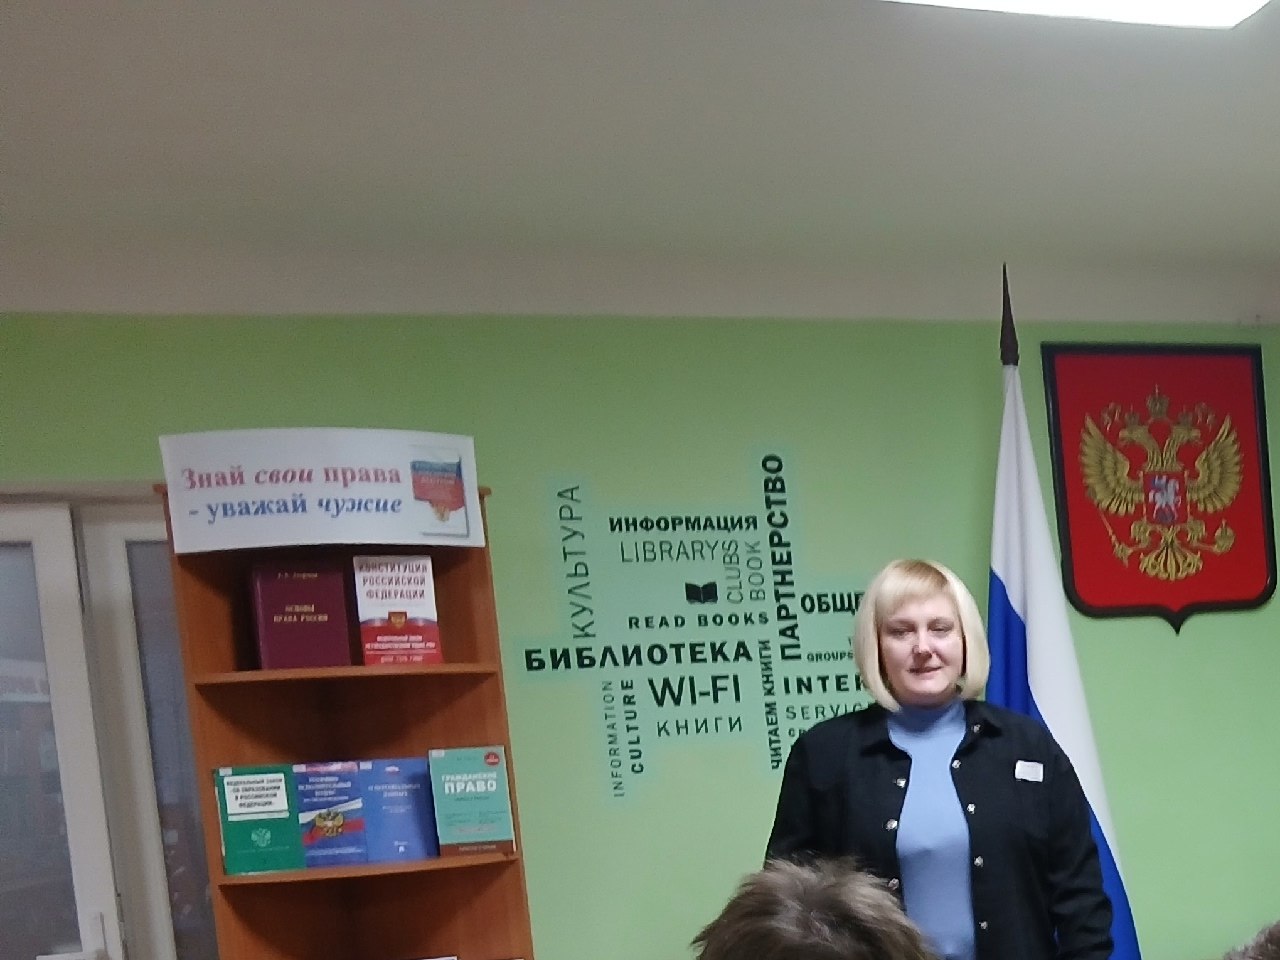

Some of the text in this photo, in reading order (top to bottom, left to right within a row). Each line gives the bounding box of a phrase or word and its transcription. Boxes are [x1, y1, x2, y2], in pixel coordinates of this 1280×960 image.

[181, 465, 246, 490] Знай
[254, 467, 314, 485] свои
[322, 466, 402, 488] права
[206, 493, 308, 525] уважай
[317, 497, 403, 519] чужие
[608, 515, 758, 533] ИНФОРМАЦИЯ
[358, 562, 428, 573] КОНСТИТУЦИЯ
[557, 485, 596, 639] КУЛЬТУРА
[721, 539, 744, 605] CLUBS
[744, 540, 766, 601] BOOK
[761, 454, 802, 661] ПАРТНЕРСТВО
[362, 575, 426, 587] РОССИЙСКОЙ
[366, 588, 425, 601] ФЕДЕРАЦИИ
[628, 611, 769, 630] READ BOOKS
[524, 640, 753, 672] БИБЛИОТЕКА
[647, 673, 741, 708] WI-FI
[758, 639, 783, 770] ЧИТАЕМ КНИГИ
[601, 680, 625, 798] INFORMATION
[620, 679, 645, 775] CULTURE
[656, 716, 743, 738] КНИГИ
[444, 780, 497, 795] ПРАВО
